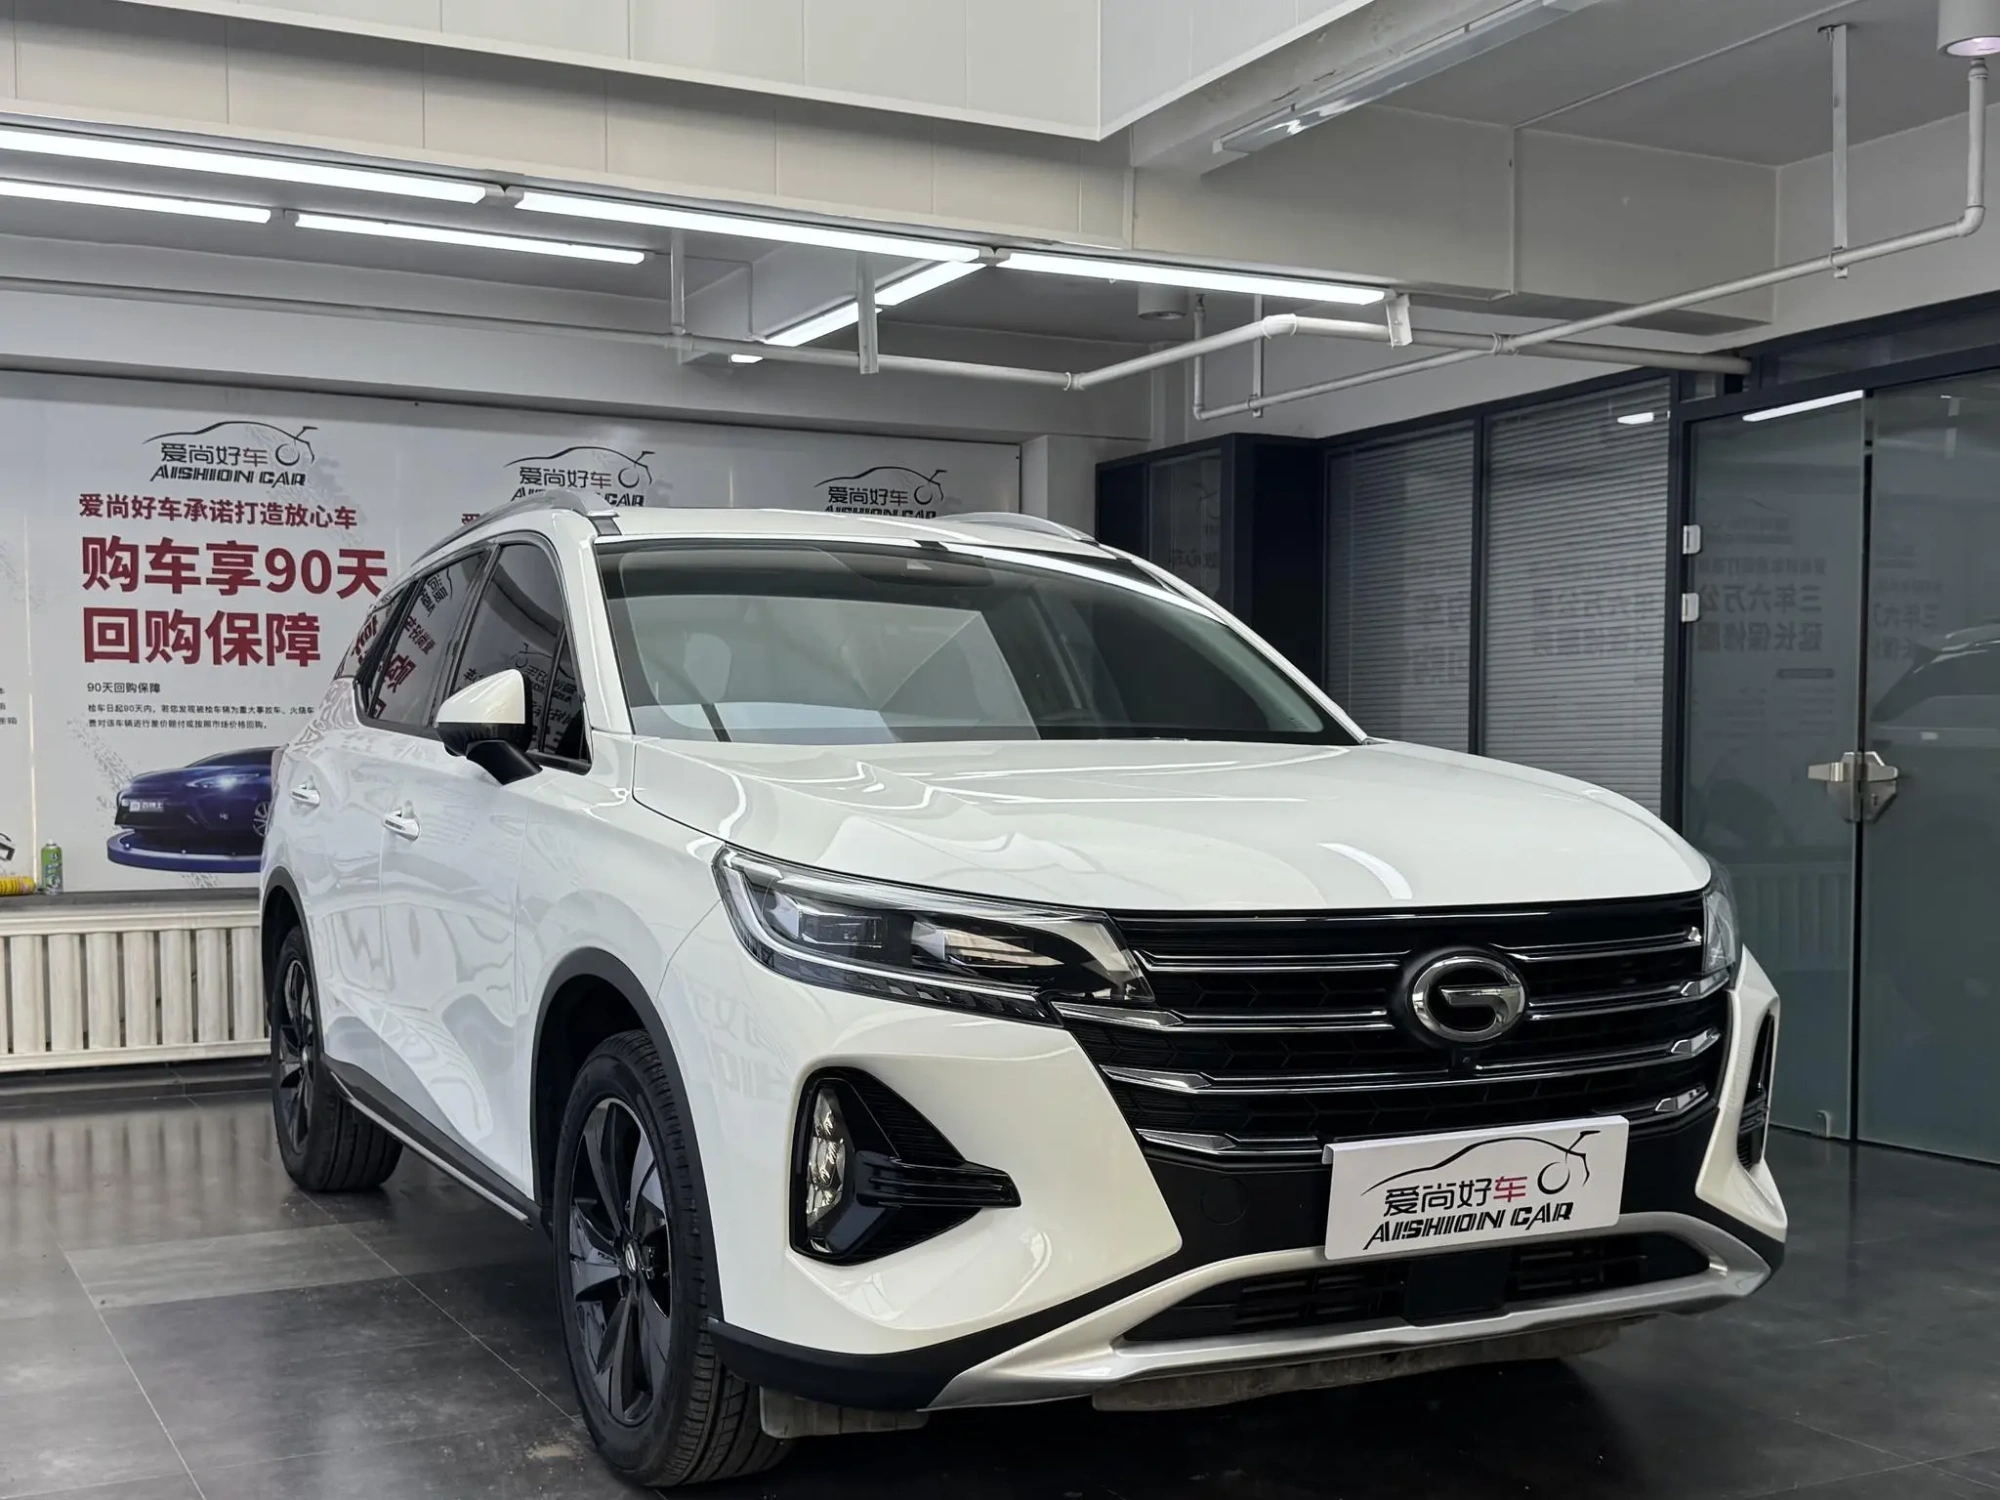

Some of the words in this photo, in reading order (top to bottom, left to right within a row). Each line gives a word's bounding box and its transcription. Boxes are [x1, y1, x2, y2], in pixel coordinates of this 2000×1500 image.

[161, 442, 268, 467] 爱尚好车
[149, 464, 254, 483] AISHION
[258, 471, 306, 488] CAR
[519, 466, 612, 489] 爱尚好车
[79, 493, 357, 530] 爱尚好车承诺打造放心车
[828, 486, 909, 506] 爱尚好车
[81, 535, 388, 599] 购车享90天
[83, 607, 321, 667] 回购保障
[87, 682, 161, 694] 90天回购保障
[1383, 1176, 1528, 1217] 爱尚好车
[1362, 1209, 1506, 1251] AISHION
[1510, 1202, 1574, 1230] CAR
